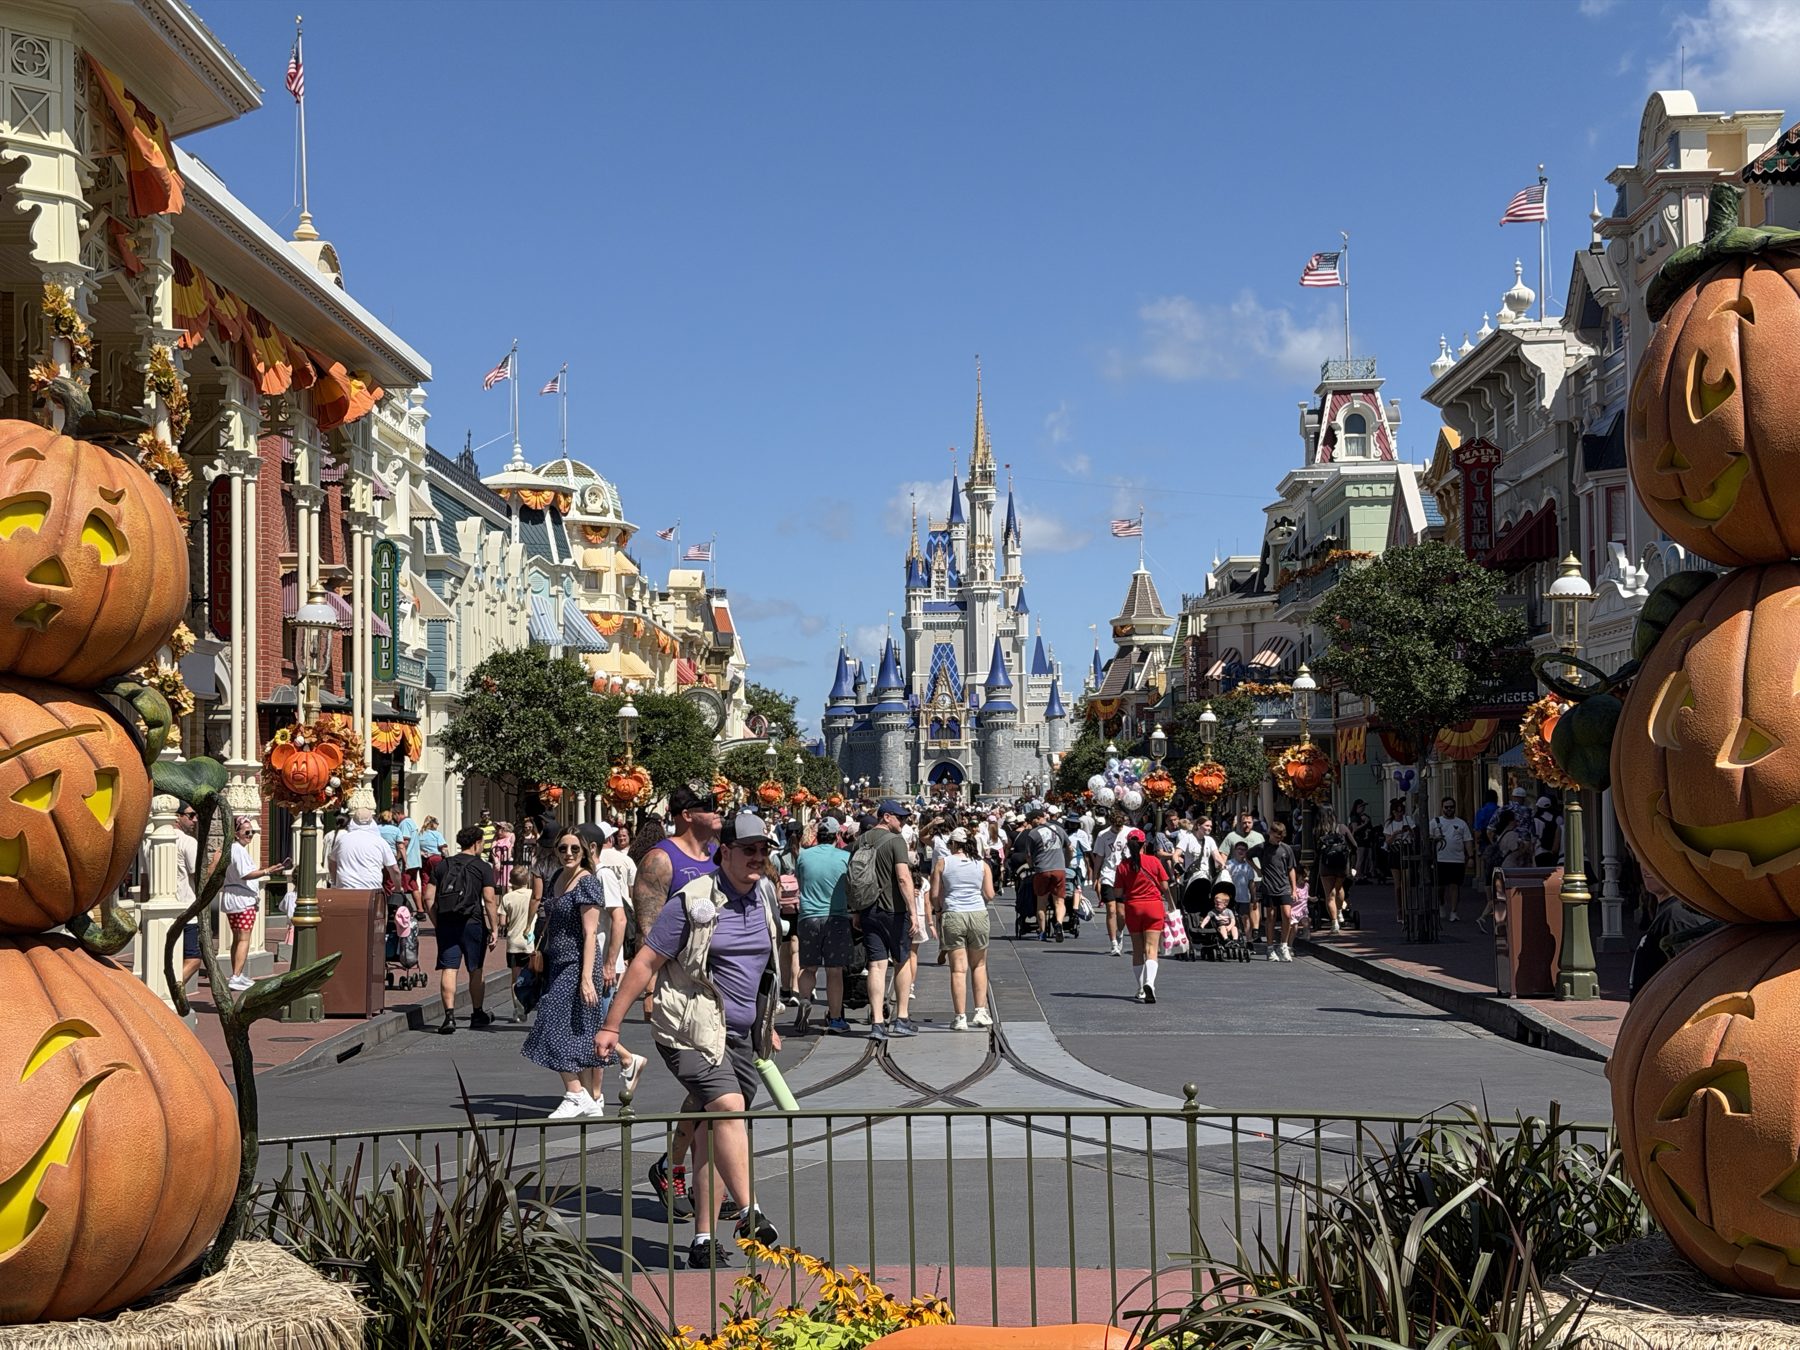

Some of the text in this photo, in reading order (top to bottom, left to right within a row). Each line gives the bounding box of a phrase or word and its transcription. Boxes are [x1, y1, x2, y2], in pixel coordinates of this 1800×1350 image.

[1459, 448, 1495, 461] MAIN
[215, 493, 231, 622] EMPORIUM
[381, 551, 391, 669] ARCADE
